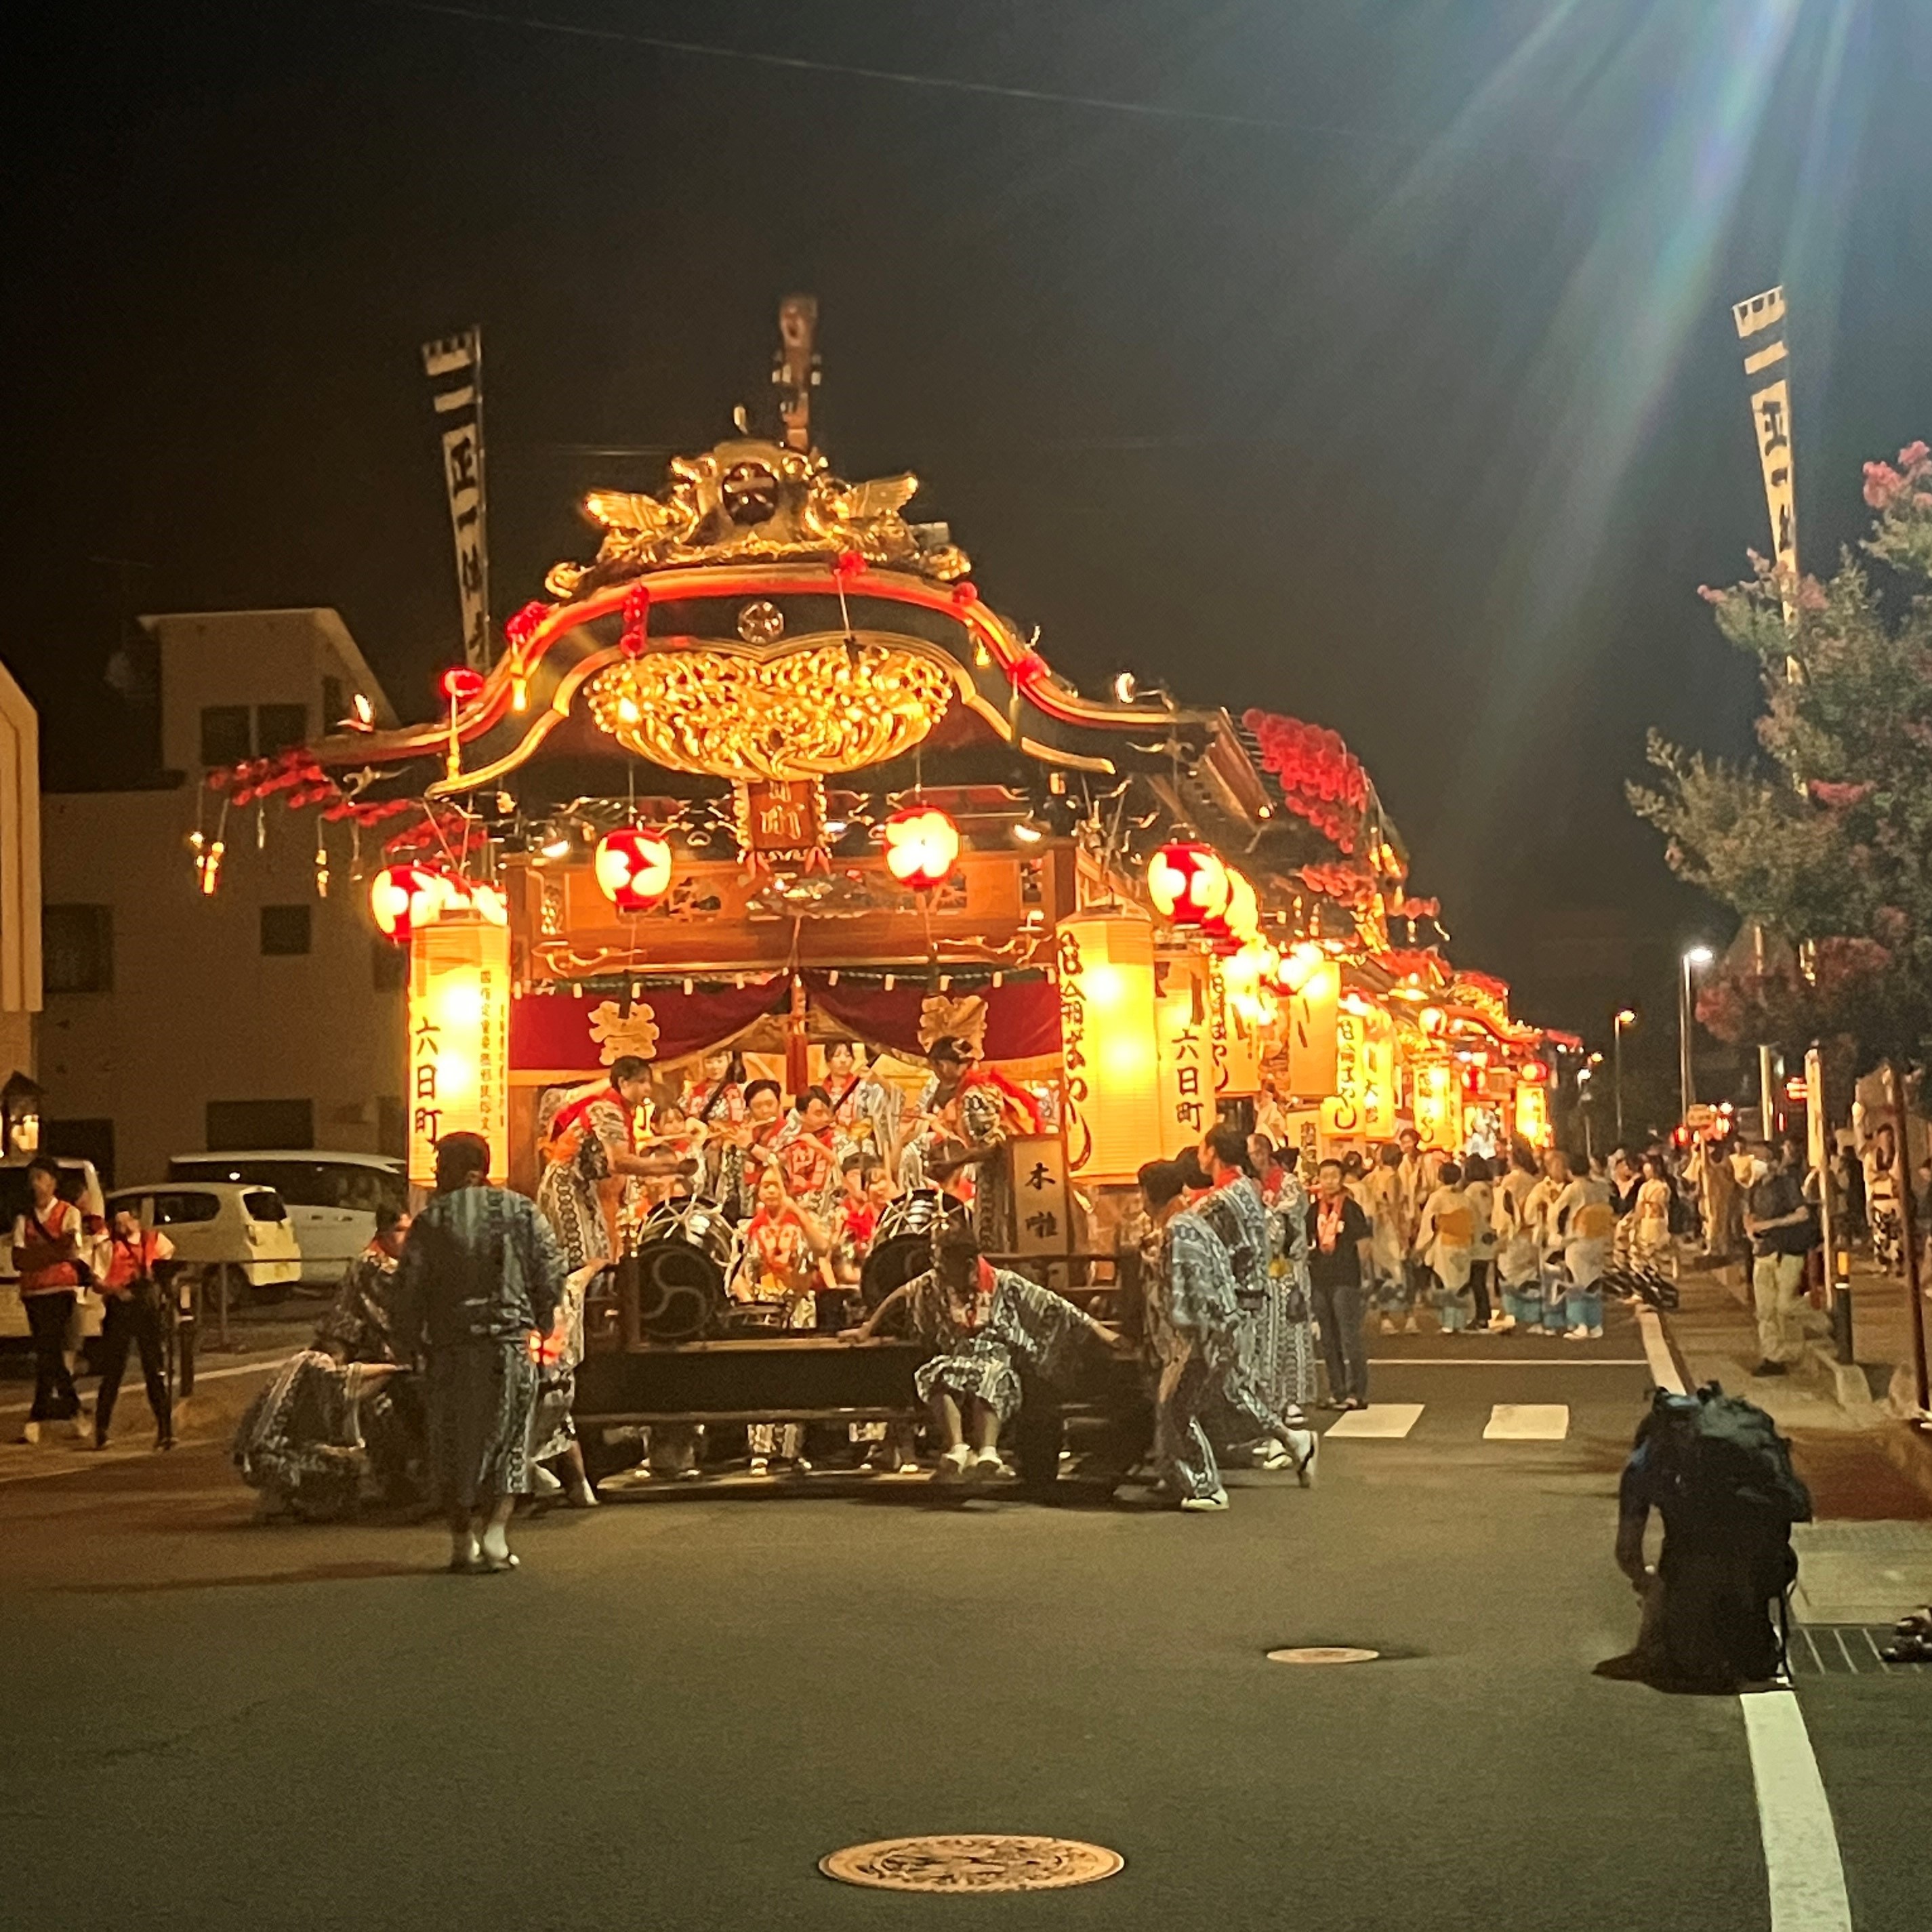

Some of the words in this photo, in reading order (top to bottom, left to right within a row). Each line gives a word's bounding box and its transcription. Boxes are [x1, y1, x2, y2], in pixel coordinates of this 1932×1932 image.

[414, 1016, 443, 1145] 六日町
[1171, 1028, 1204, 1134] 六日町
